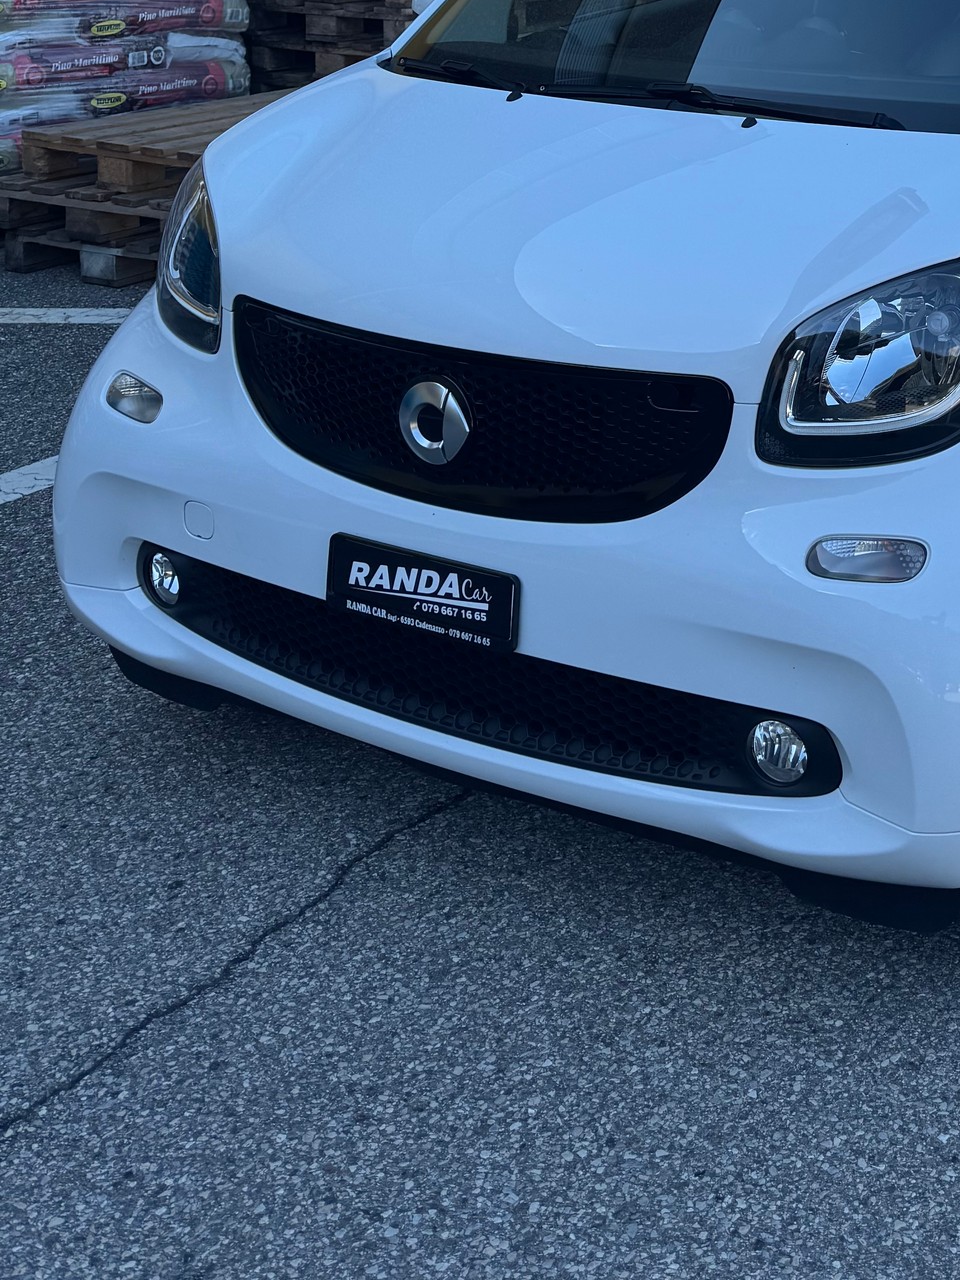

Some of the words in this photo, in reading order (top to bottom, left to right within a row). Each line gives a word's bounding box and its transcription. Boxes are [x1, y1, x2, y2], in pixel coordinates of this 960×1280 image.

[138, 11, 157, 23] Pino
[51, 60, 72, 72] Pino
[73, 54, 119, 67] Marittimo
[138, 84, 158, 95] Pino
[348, 561, 460, 599] RANDA
[461, 578, 492, 602] Car
[421, 602, 440, 614] 079
[441, 606, 459, 617] 667
[461, 609, 473, 620] 16
[474, 611, 487, 622] 65
[346, 599, 372, 615] RANDA
[372, 606, 387, 619] CAR
[448, 628, 461, 639] 079
[461, 631, 473, 642] 667
[473, 634, 482, 644] 16
[482, 637, 491, 647] 65
